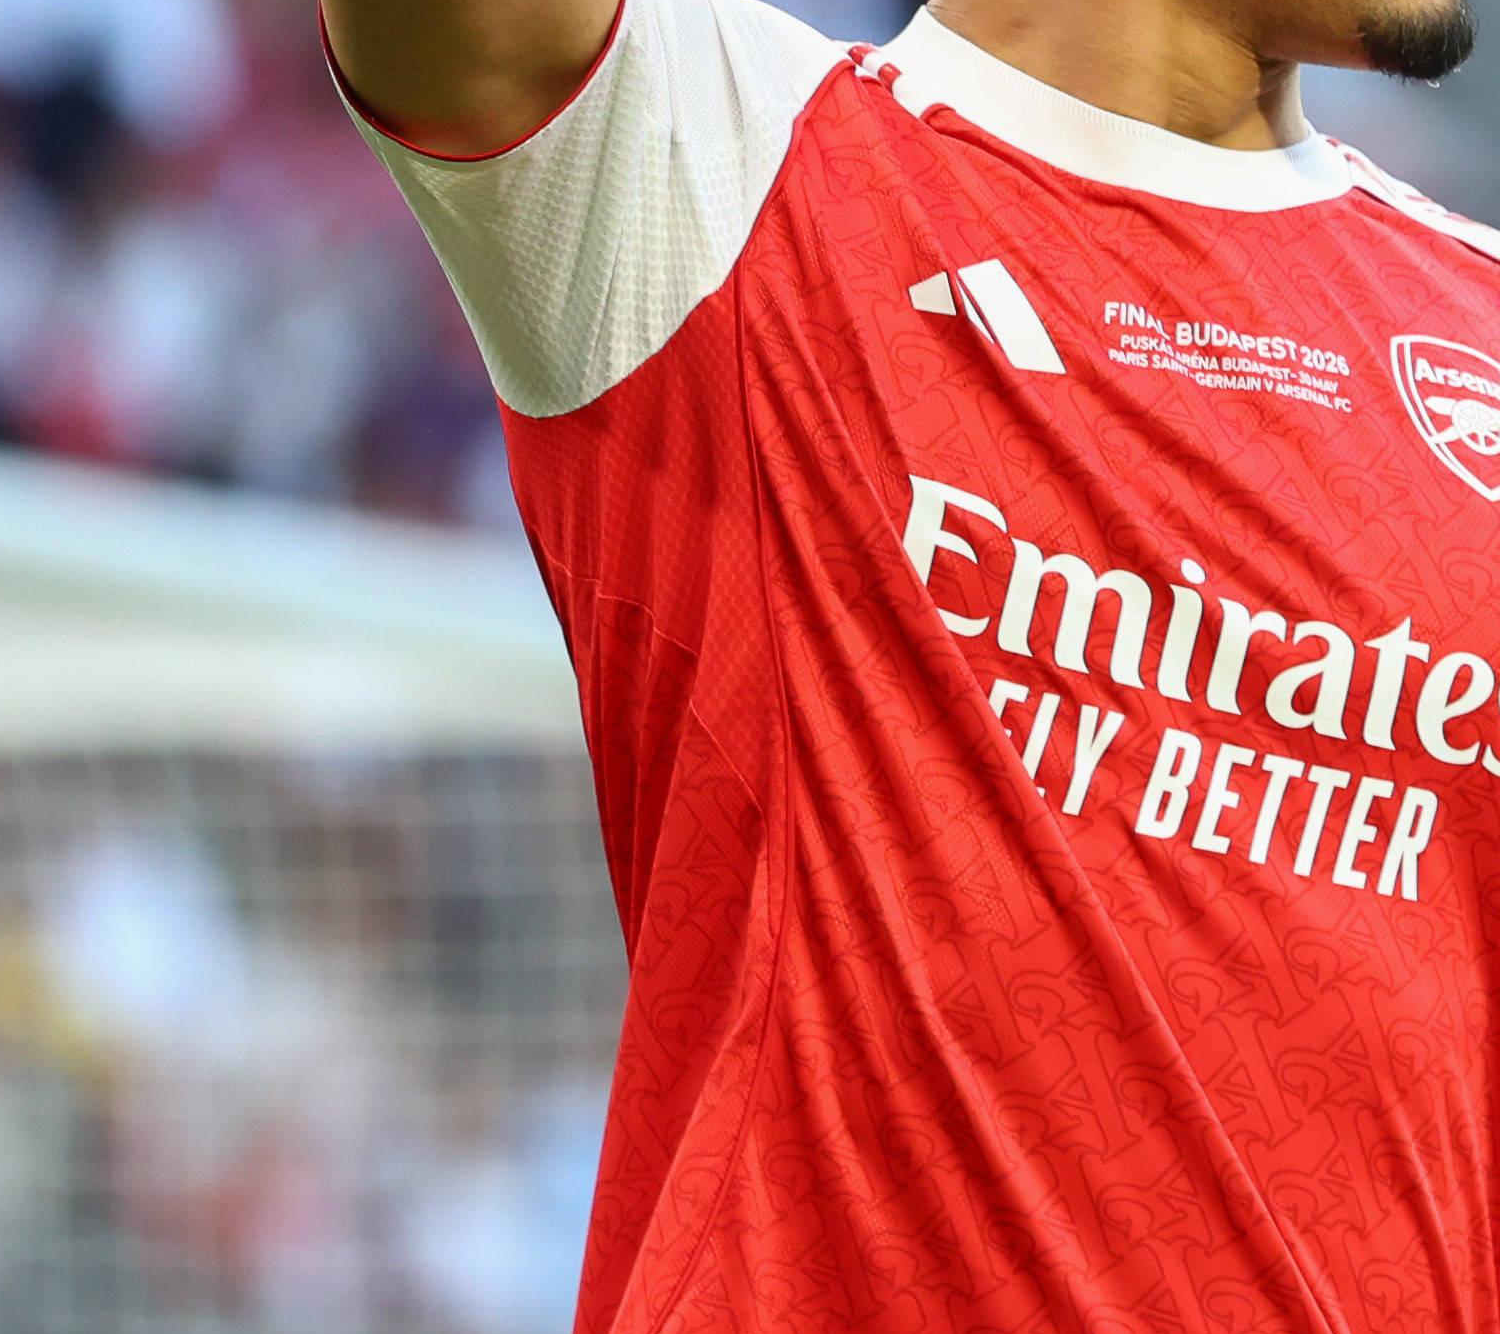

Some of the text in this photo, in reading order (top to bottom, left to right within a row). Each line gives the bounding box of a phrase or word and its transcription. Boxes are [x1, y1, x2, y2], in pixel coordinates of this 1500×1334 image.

[1104, 301, 1350, 376] FINAL BUDAPEST 2026
[1108, 348, 1148, 368] PARIS
[1263, 378, 1274, 393] V
[1275, 382, 1334, 409] ARSENAL
[1333, 396, 1353, 413] FC
[1312, 376, 1338, 394] MAY
[1134, 728, 1438, 902] BETTER
